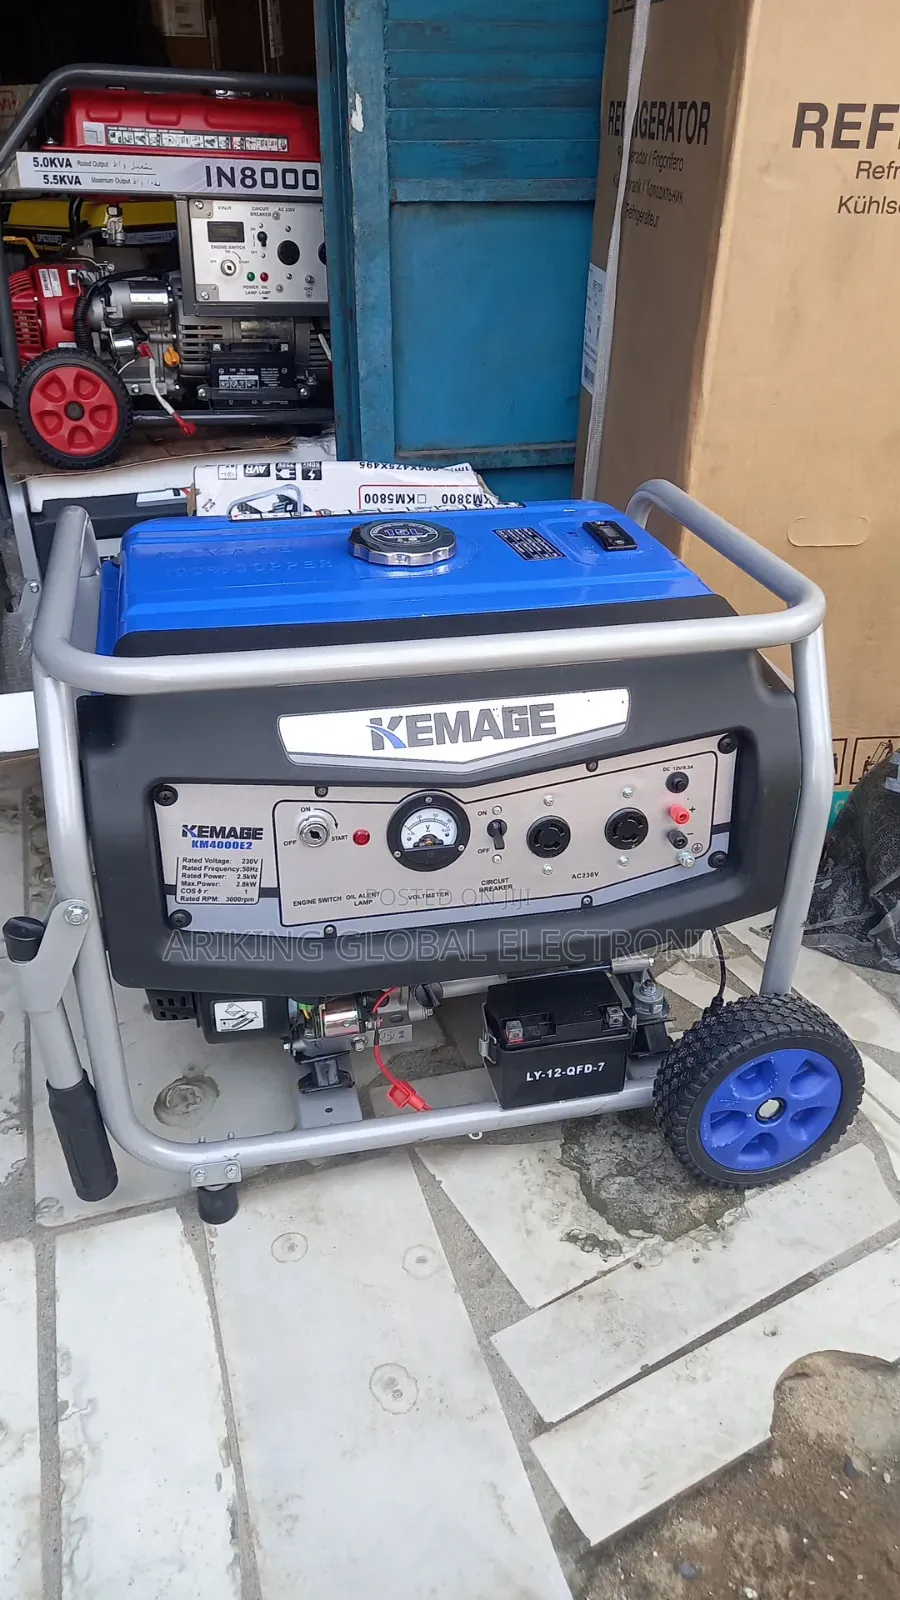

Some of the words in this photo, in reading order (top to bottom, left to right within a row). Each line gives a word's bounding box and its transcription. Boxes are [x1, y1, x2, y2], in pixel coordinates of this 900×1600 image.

[608, 100, 711, 146] REFIGERATOR
[792, 102, 900, 150] REF
[32, 156, 73, 168] 5.0KVA
[43, 174, 82, 186] 5.5KVA
[205, 164, 320, 190] IN8000
[837, 195, 900, 215] Kühls
[244, 463, 267, 473] AVR
[364, 493, 416, 505] KM5800
[366, 703, 557, 751] KEMAGE
[181, 824, 264, 841] KEMAGE
[331, 834, 349, 842] START
[191, 839, 253, 850] KM4000E2
[283, 839, 297, 847] OFF
[477, 847, 491, 855] OFF
[204, 857, 232, 865] Voltage:
[571, 871, 600, 880] AC230V
[480, 877, 510, 886] CIRCUIT
[478, 884, 513, 893] BREAKER
[358, 891, 381, 899] ALERT
[407, 891, 450, 901] VOLTMETER
[292, 898, 317, 907] ENGINE
[317, 895, 342, 904] SWITCH
[353, 899, 373, 907] LAMP
[526, 1061, 606, 1082] LY-12-QFD-7
